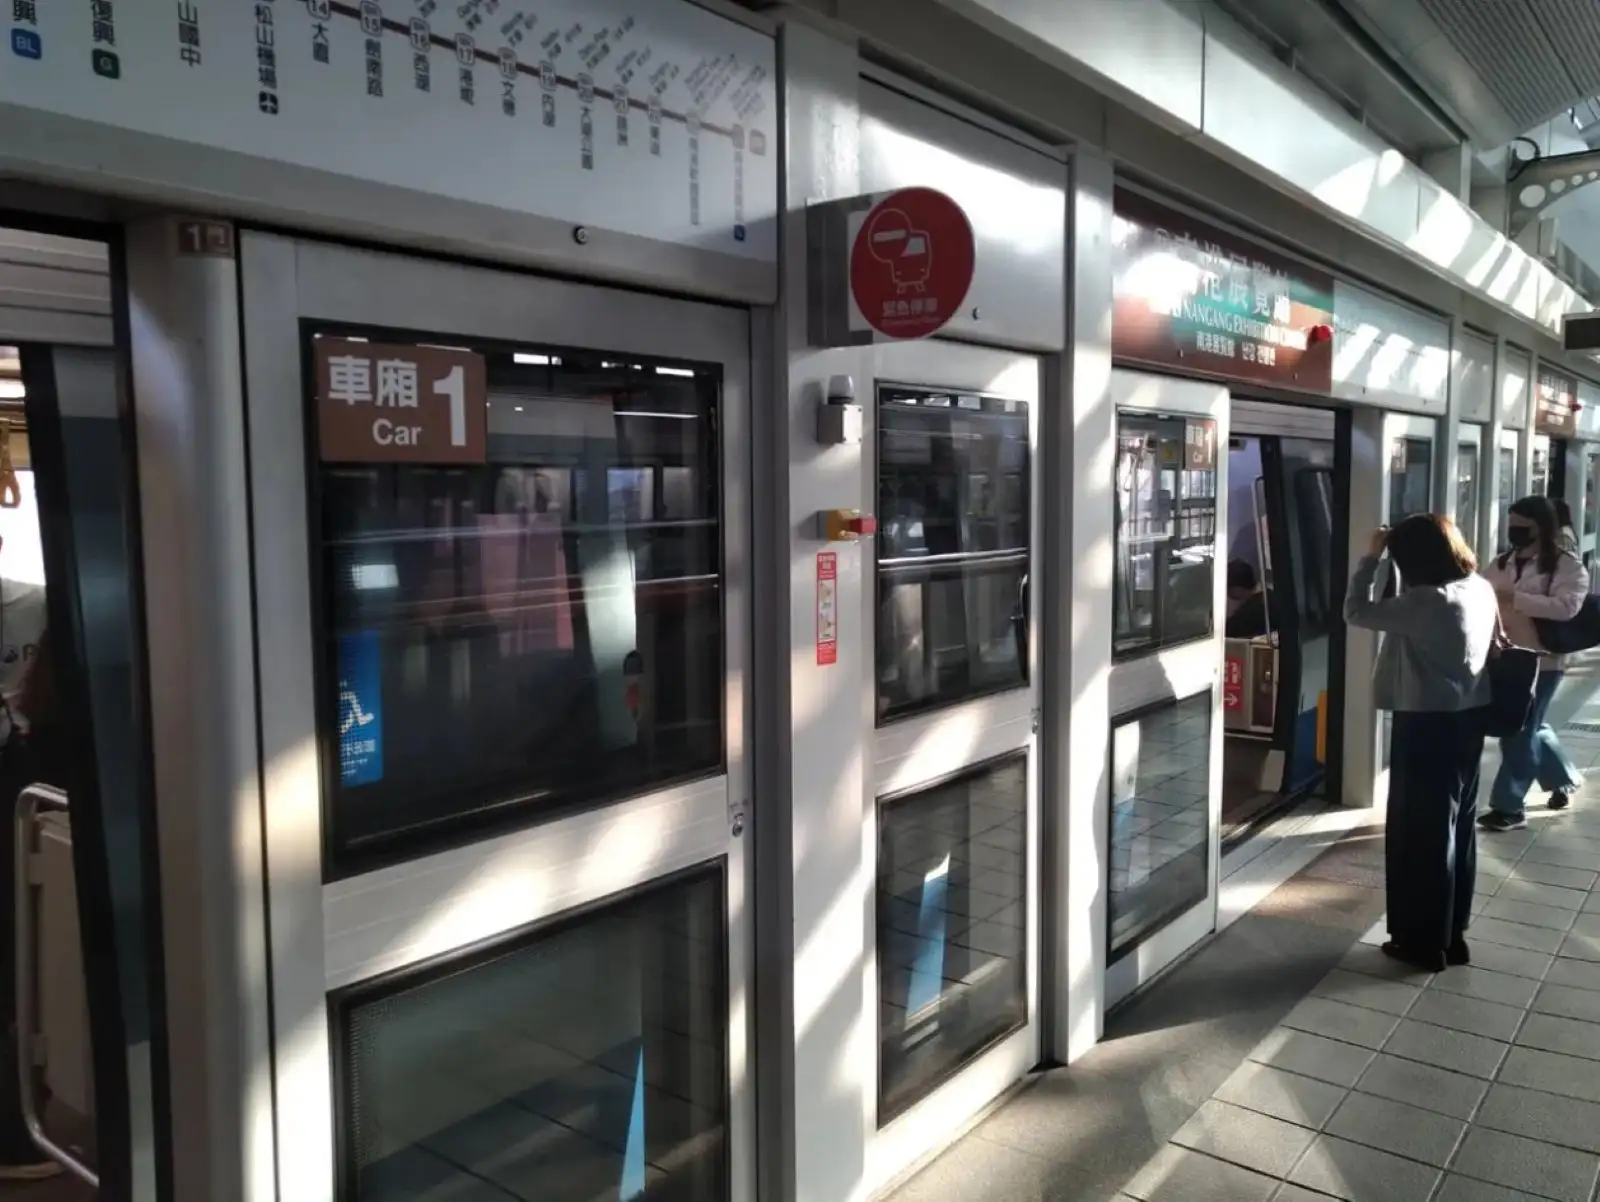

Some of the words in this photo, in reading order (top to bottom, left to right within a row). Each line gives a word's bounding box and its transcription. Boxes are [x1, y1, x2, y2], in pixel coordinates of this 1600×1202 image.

[328, 355, 418, 408] 車廂
[433, 365, 466, 446] 1
[372, 418, 422, 446] Car
